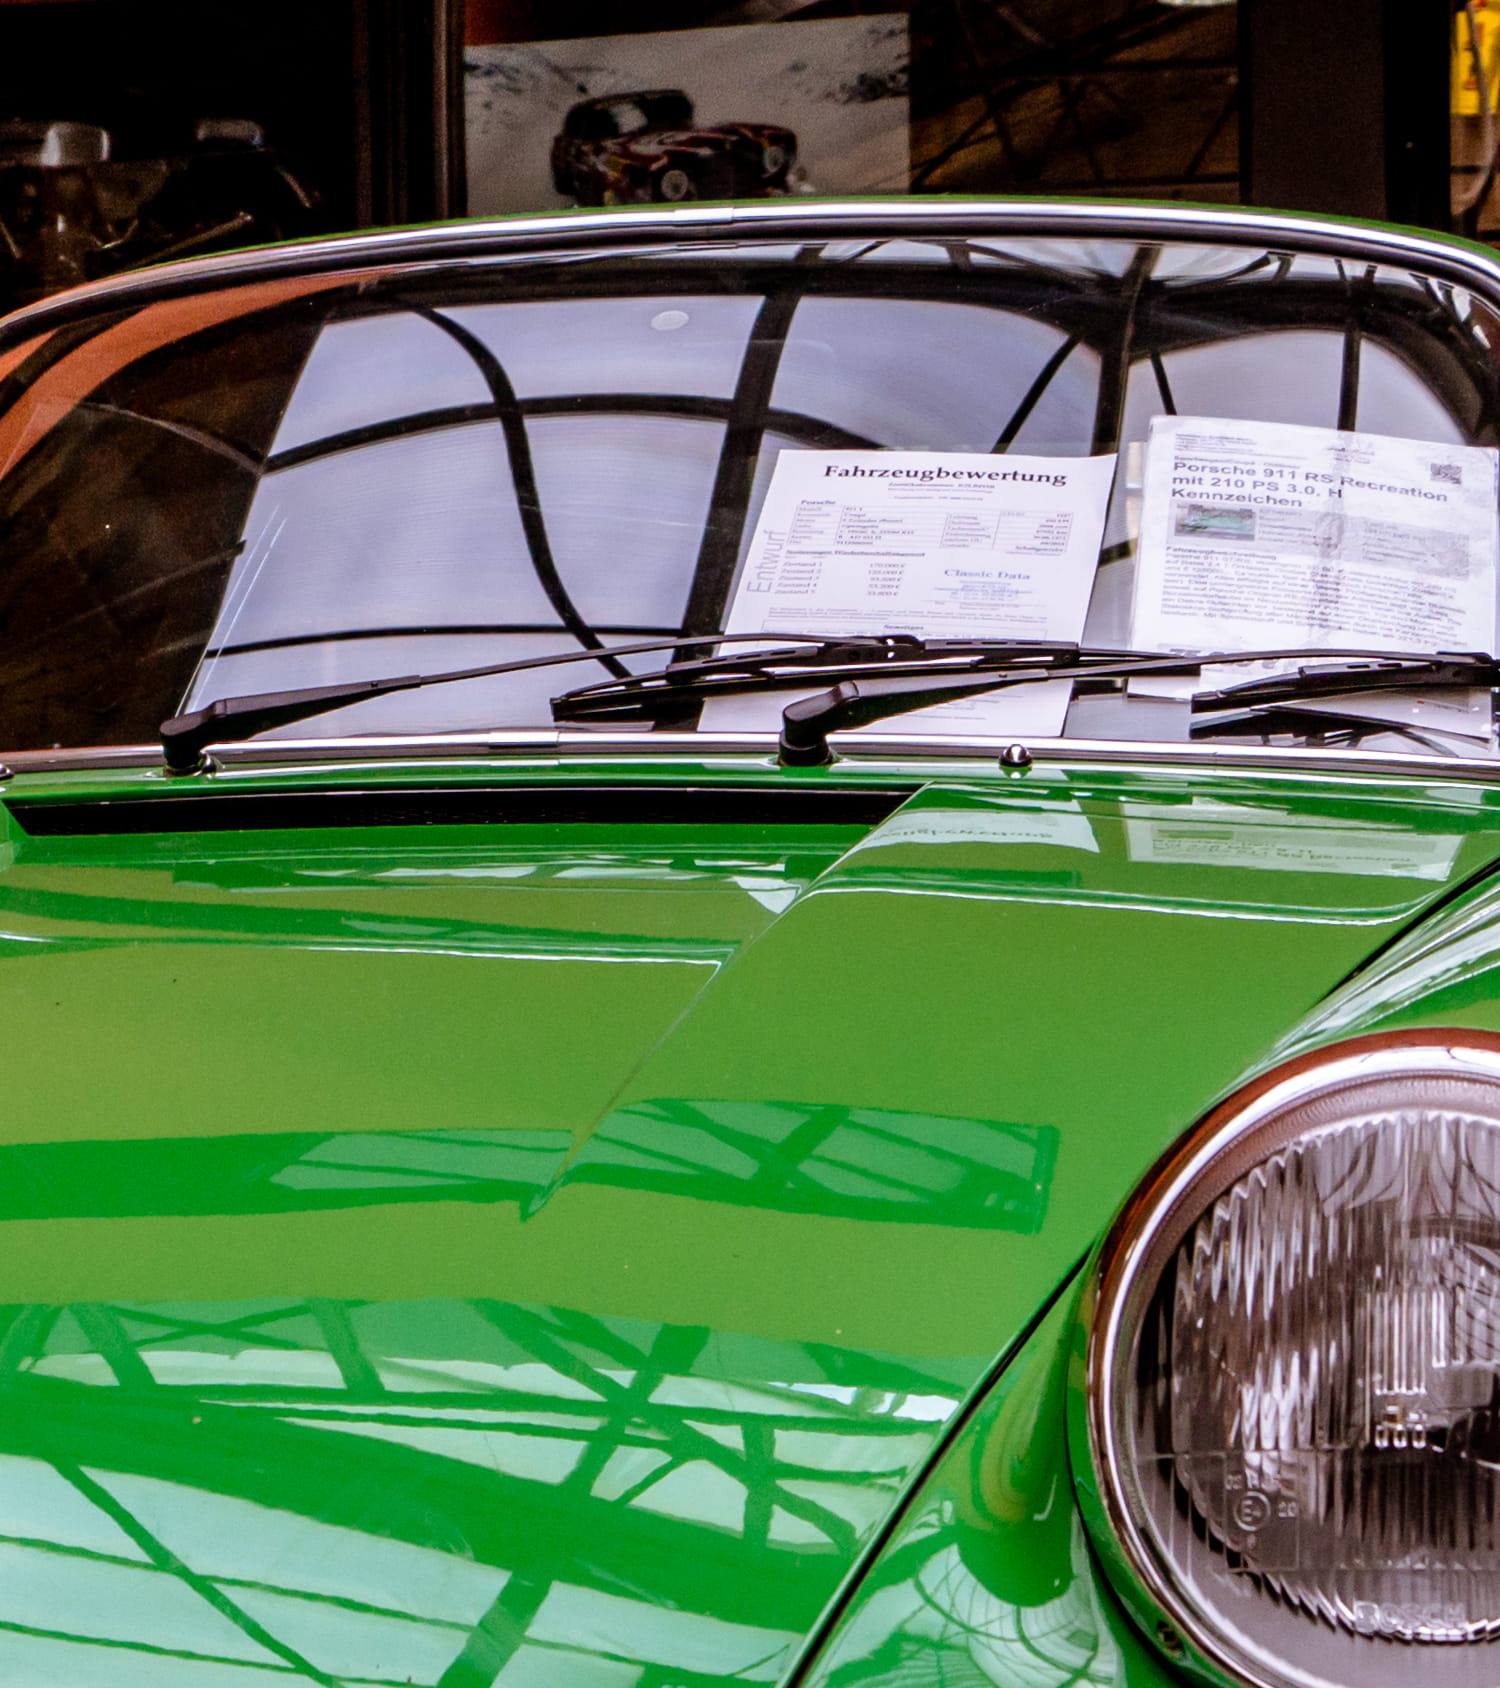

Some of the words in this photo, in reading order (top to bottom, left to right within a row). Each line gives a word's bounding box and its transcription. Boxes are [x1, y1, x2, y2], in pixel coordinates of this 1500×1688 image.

[824, 464, 1069, 487] Fahrzeugbewertung
[1171, 475, 1203, 486] mit
[1210, 477, 1245, 490] 210
[1252, 480, 1280, 492] PS
[1328, 487, 1343, 499] H
[1173, 461, 1257, 477] Porsche
[1263, 467, 1297, 481] 911
[1304, 471, 1333, 484] RS
[1340, 474, 1449, 502] Recreation
[1171, 487, 1303, 508] Kennzeichen
[746, 529, 788, 593] Entwurf
[997, 570, 1031, 580] Data
